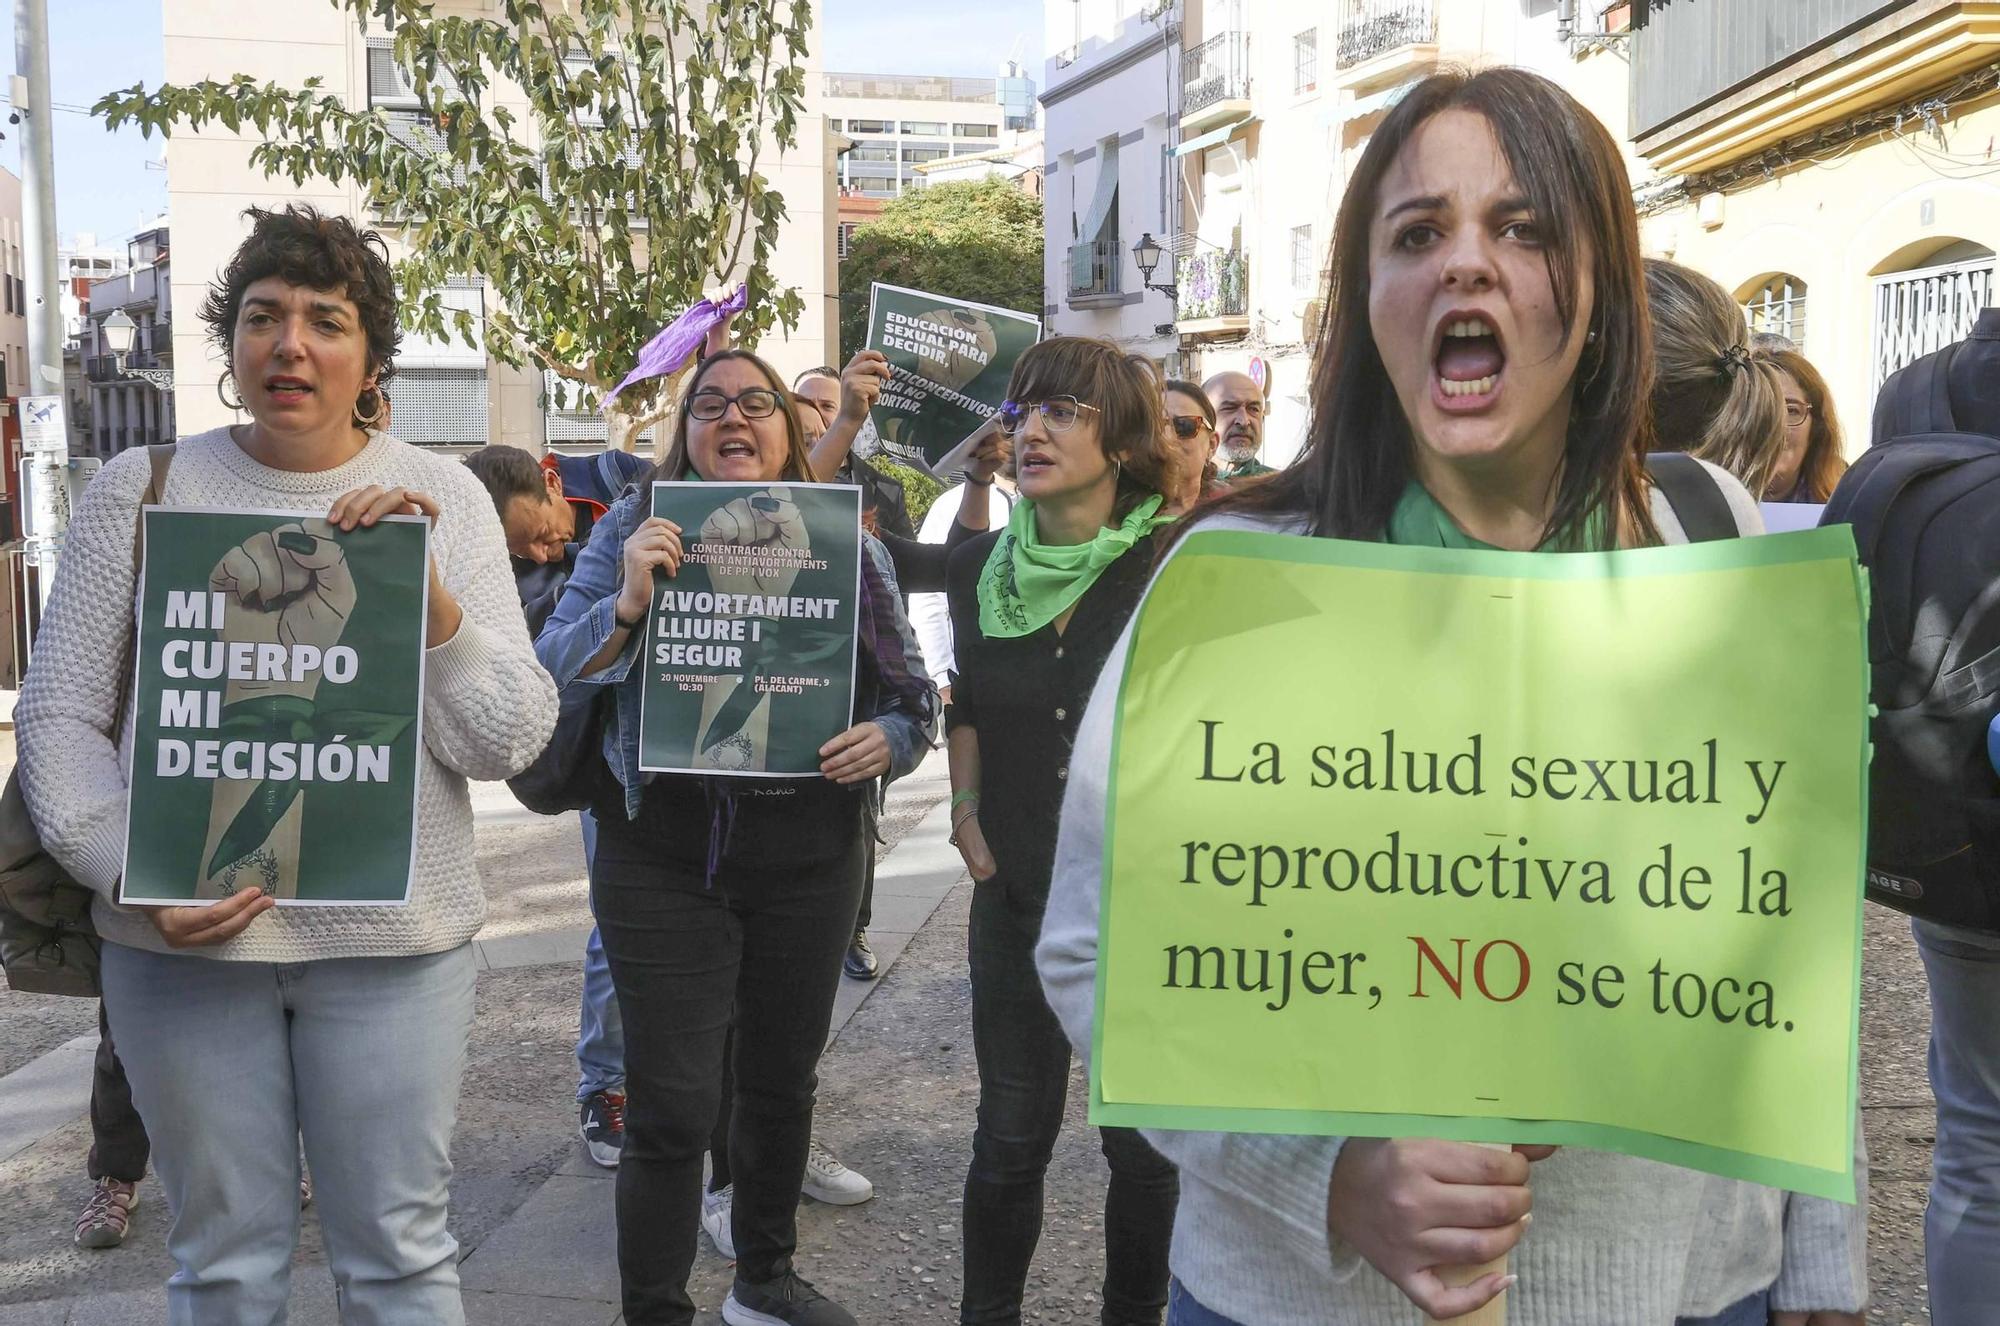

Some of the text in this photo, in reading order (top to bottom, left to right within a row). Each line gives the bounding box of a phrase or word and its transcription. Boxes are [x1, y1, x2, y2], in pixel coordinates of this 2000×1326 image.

[886, 311, 977, 344] EDUCACIÓN
[882, 334, 949, 368] DECIDIR,
[884, 322, 989, 366] SEXUAL PARA
[879, 377, 927, 400] ARA NO
[888, 363, 996, 418] NTICONCEPTIVOS
[683, 553, 828, 570] OFICINA ANTIAVORTAMENTS
[691, 543, 812, 559] CONCENTRACIÓ CONTRA
[719, 566, 732, 576] DE
[735, 567, 748, 576] PP
[758, 568, 780, 578] VOX
[163, 589, 226, 630] MI
[659, 590, 840, 619] AVORTAMENT
[657, 616, 761, 642] LLIURE I
[161, 639, 359, 685] CUERPO
[655, 643, 742, 668] SEGUR
[661, 673, 719, 684] 20 NOVEMBRE
[678, 683, 703, 692] 10:30
[754, 675, 830, 687] PL. DEL CARME, 9
[754, 684, 803, 695] (ALACANT)
[158, 688, 221, 729] MI
[156, 734, 391, 783] DECISIÓN
[1196, 719, 1787, 825] La salud sexual y
[1180, 831, 1793, 918] reproductiva de la
[1162, 929, 1794, 1032] mujer, NO se toca.
